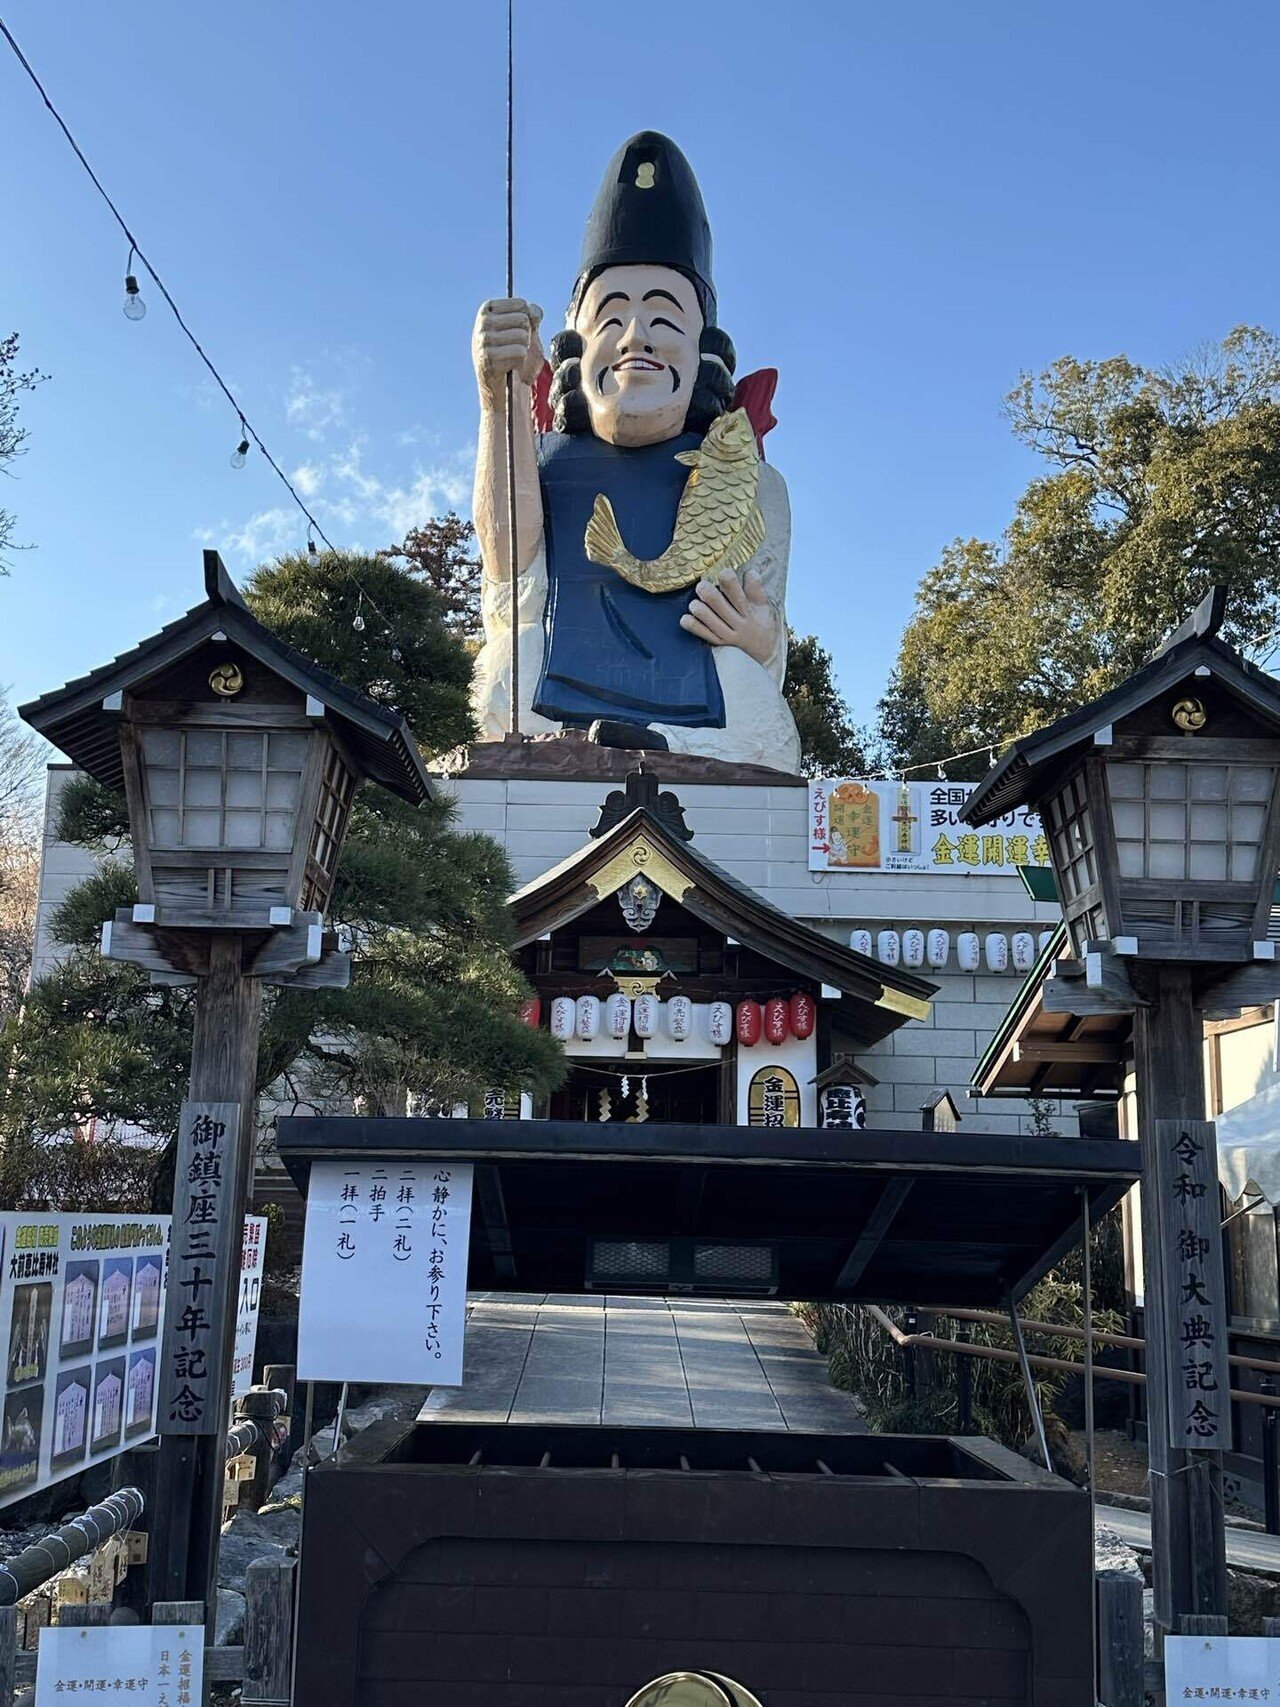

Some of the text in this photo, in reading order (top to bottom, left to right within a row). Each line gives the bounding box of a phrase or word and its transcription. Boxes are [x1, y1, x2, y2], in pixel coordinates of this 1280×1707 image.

[813, 787, 827, 840] えびす様
[931, 832, 1050, 867] 金運開運幸
[711, 1003, 724, 1039] えびす様
[771, 1003, 784, 1037] えびす様
[368, 1169, 388, 1222] 二拍手
[169, 1114, 226, 1423] 御鎮座三十年記念
[426, 1170, 450, 1359] 心静かに、お参り下さい。
[1171, 1131, 1218, 1438] 令和 御大典記念
[239, 1277, 260, 1315] 入口
[157, 1650, 171, 1707] 日本一之
